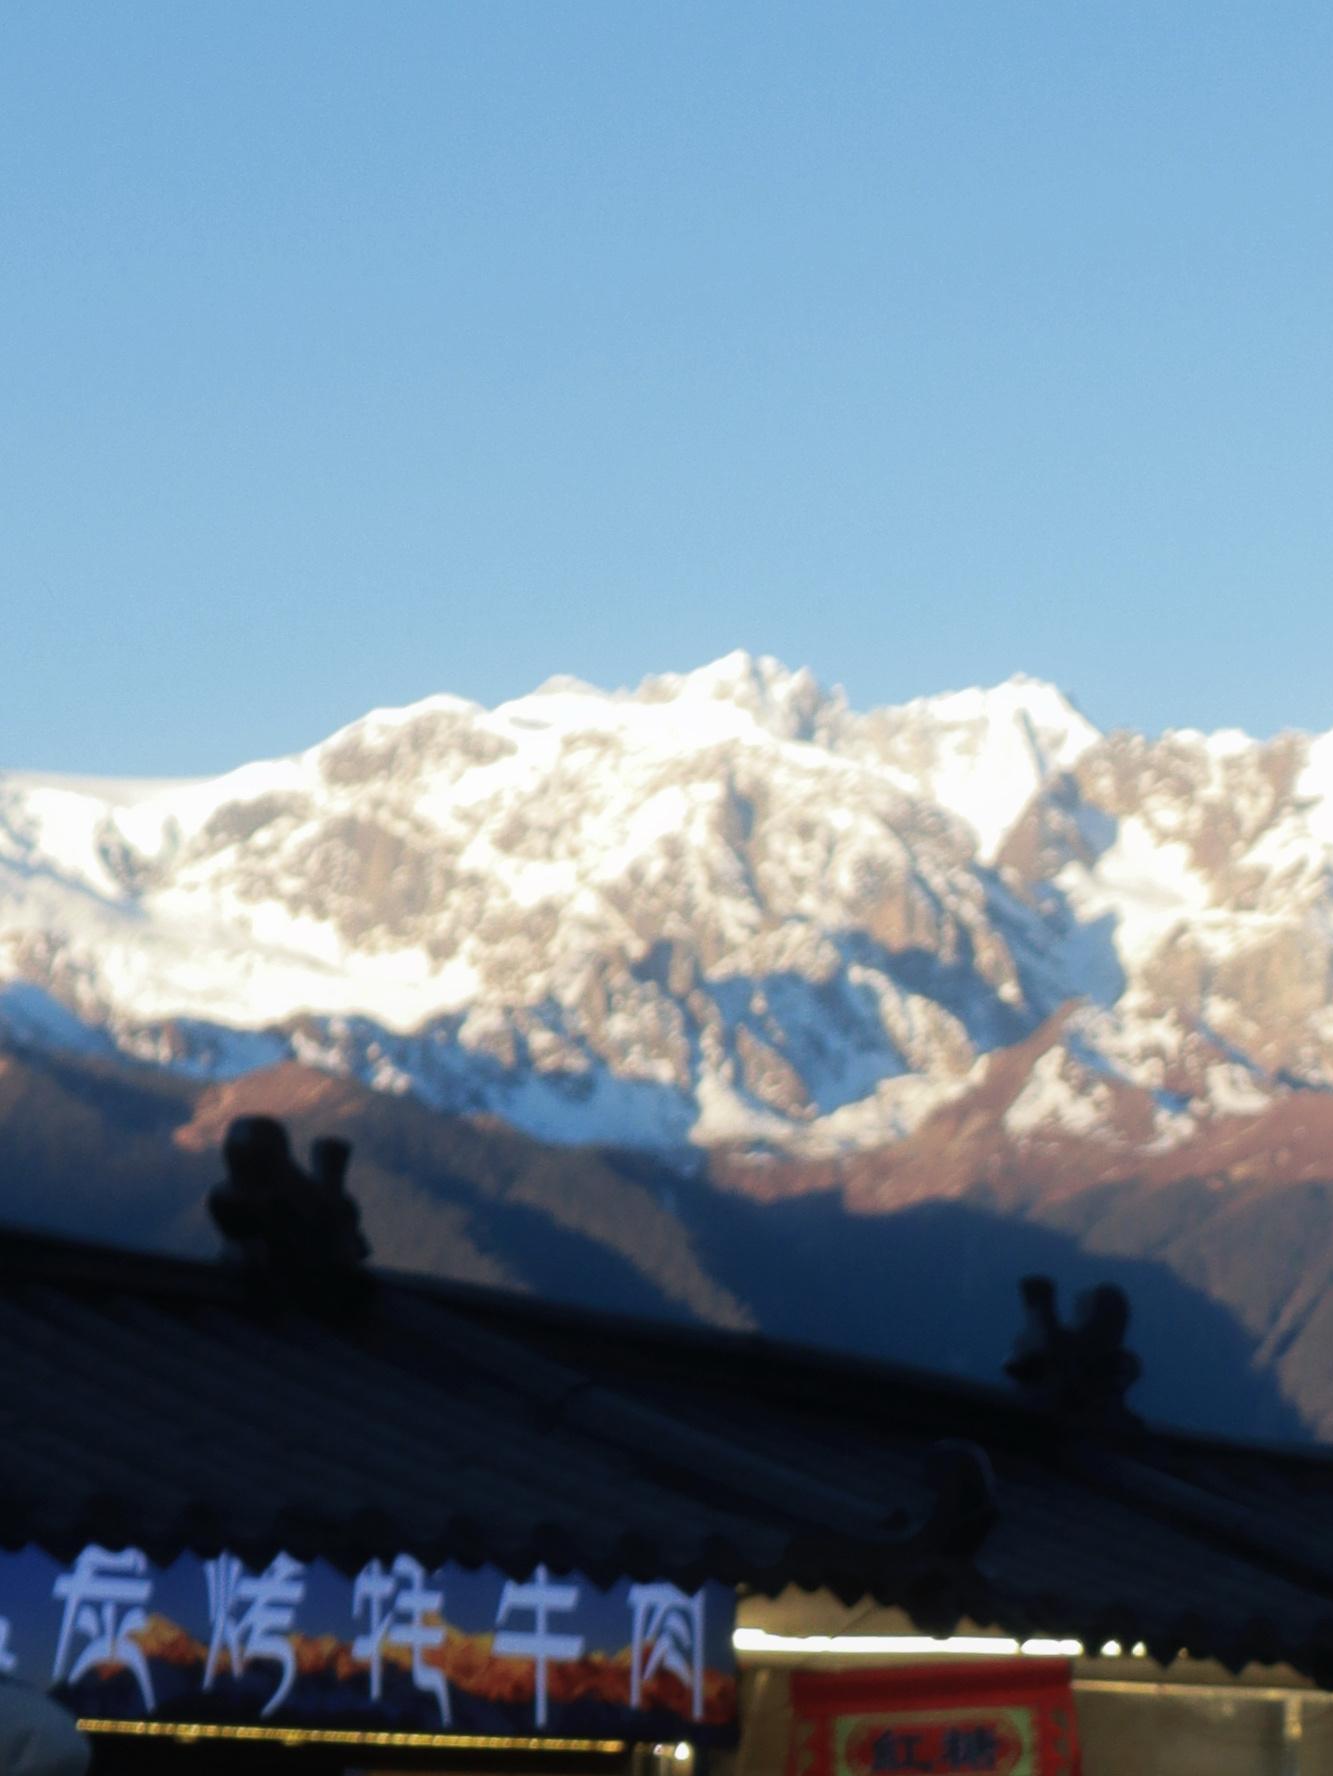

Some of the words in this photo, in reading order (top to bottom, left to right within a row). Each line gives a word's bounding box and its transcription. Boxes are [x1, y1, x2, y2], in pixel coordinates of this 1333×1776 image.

[0, 1542, 706, 1728] 炭烤牦牛肉
